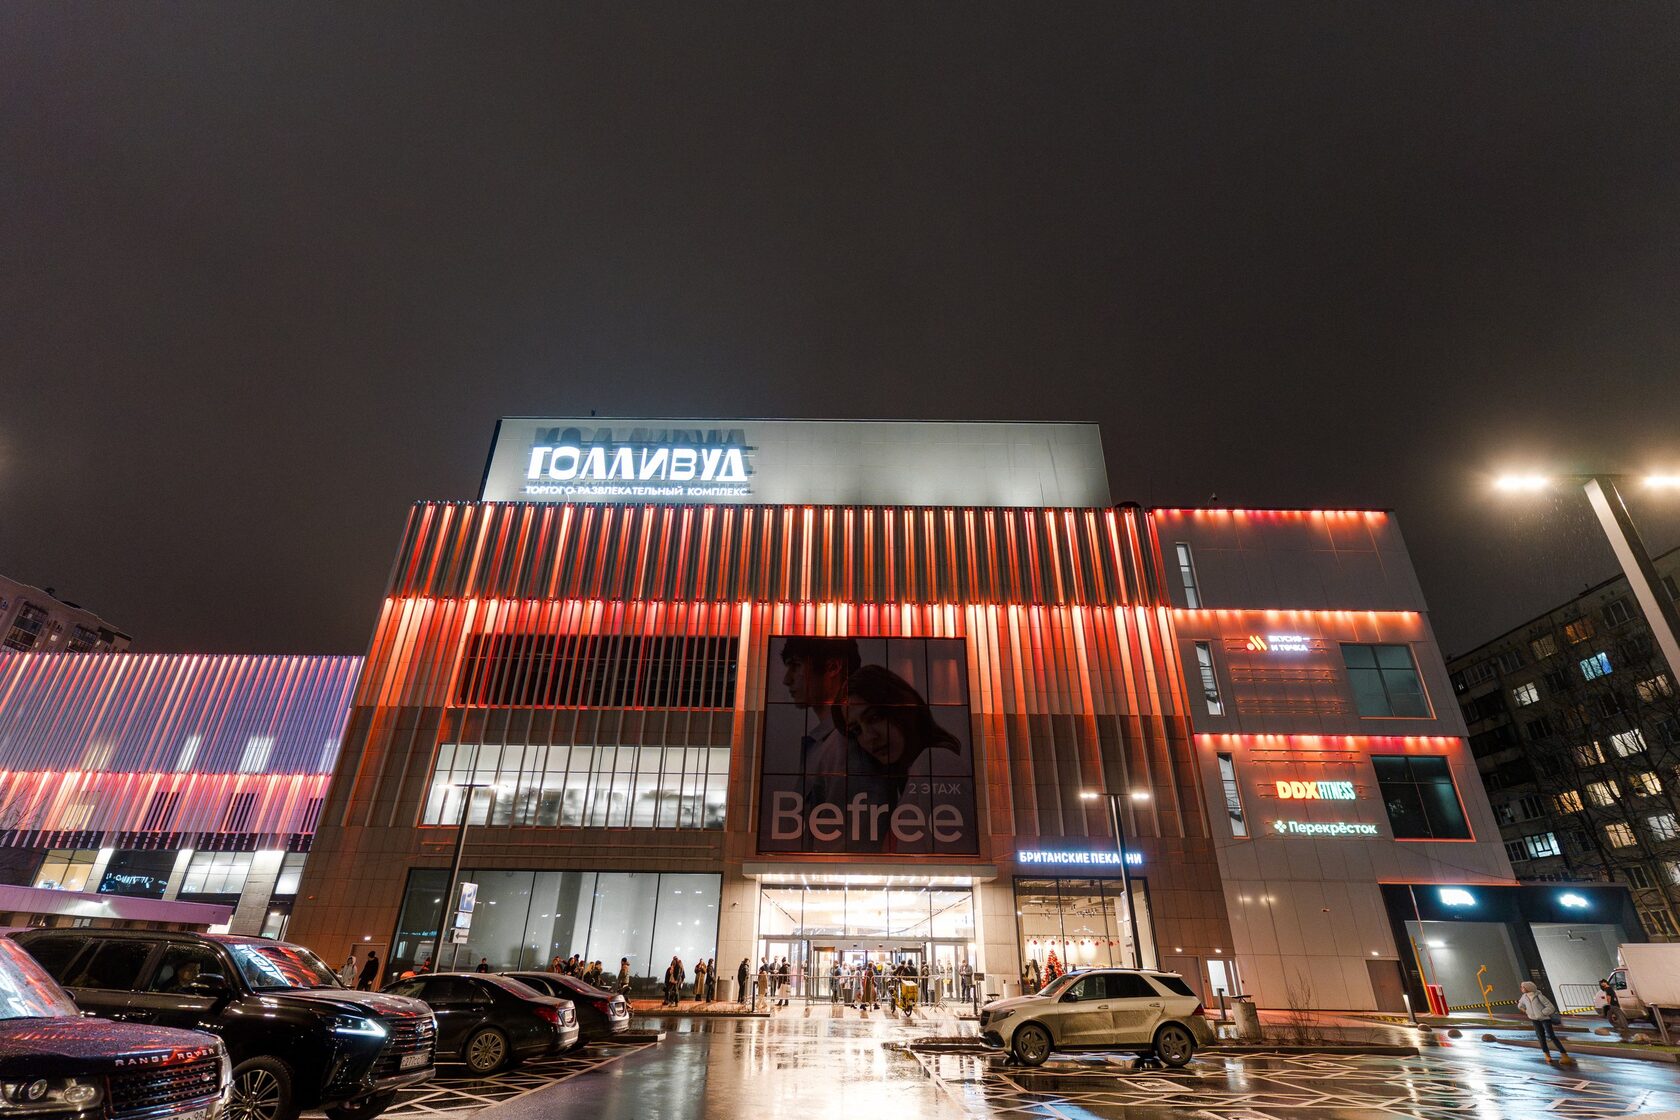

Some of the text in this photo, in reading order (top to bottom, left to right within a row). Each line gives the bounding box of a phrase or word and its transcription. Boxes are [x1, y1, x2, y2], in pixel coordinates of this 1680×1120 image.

[527, 446, 748, 482] ГОЛЛИВУД
[687, 487, 748, 496] КОМПЛЕКС
[909, 783, 961, 795] 2 ЭТАЖ
[771, 791, 964, 843] Befree
[1288, 821, 1378, 836] Перекрёсток
[1019, 851, 1142, 864] БРИТАНСКИЕ ПЕКАНИ
[115, 1048, 215, 1068] RANGE ROVER
